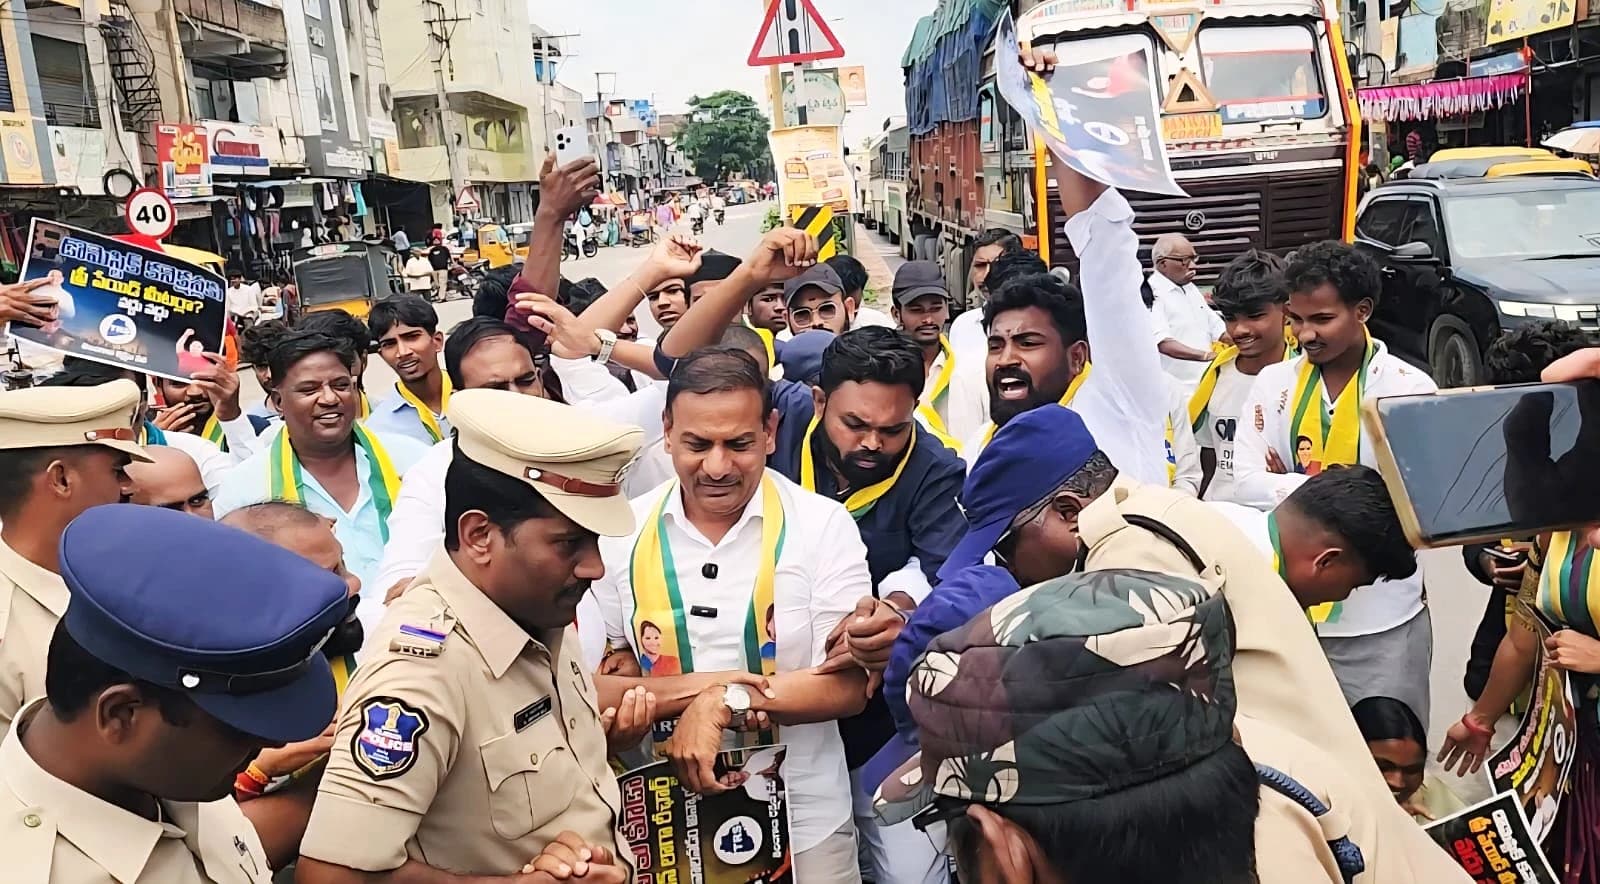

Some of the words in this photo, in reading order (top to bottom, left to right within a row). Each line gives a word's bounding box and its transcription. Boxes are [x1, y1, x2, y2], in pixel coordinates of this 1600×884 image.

[136, 204, 167, 224] 40
[360, 730, 414, 752] POLICE
[731, 822, 744, 852] TRS
